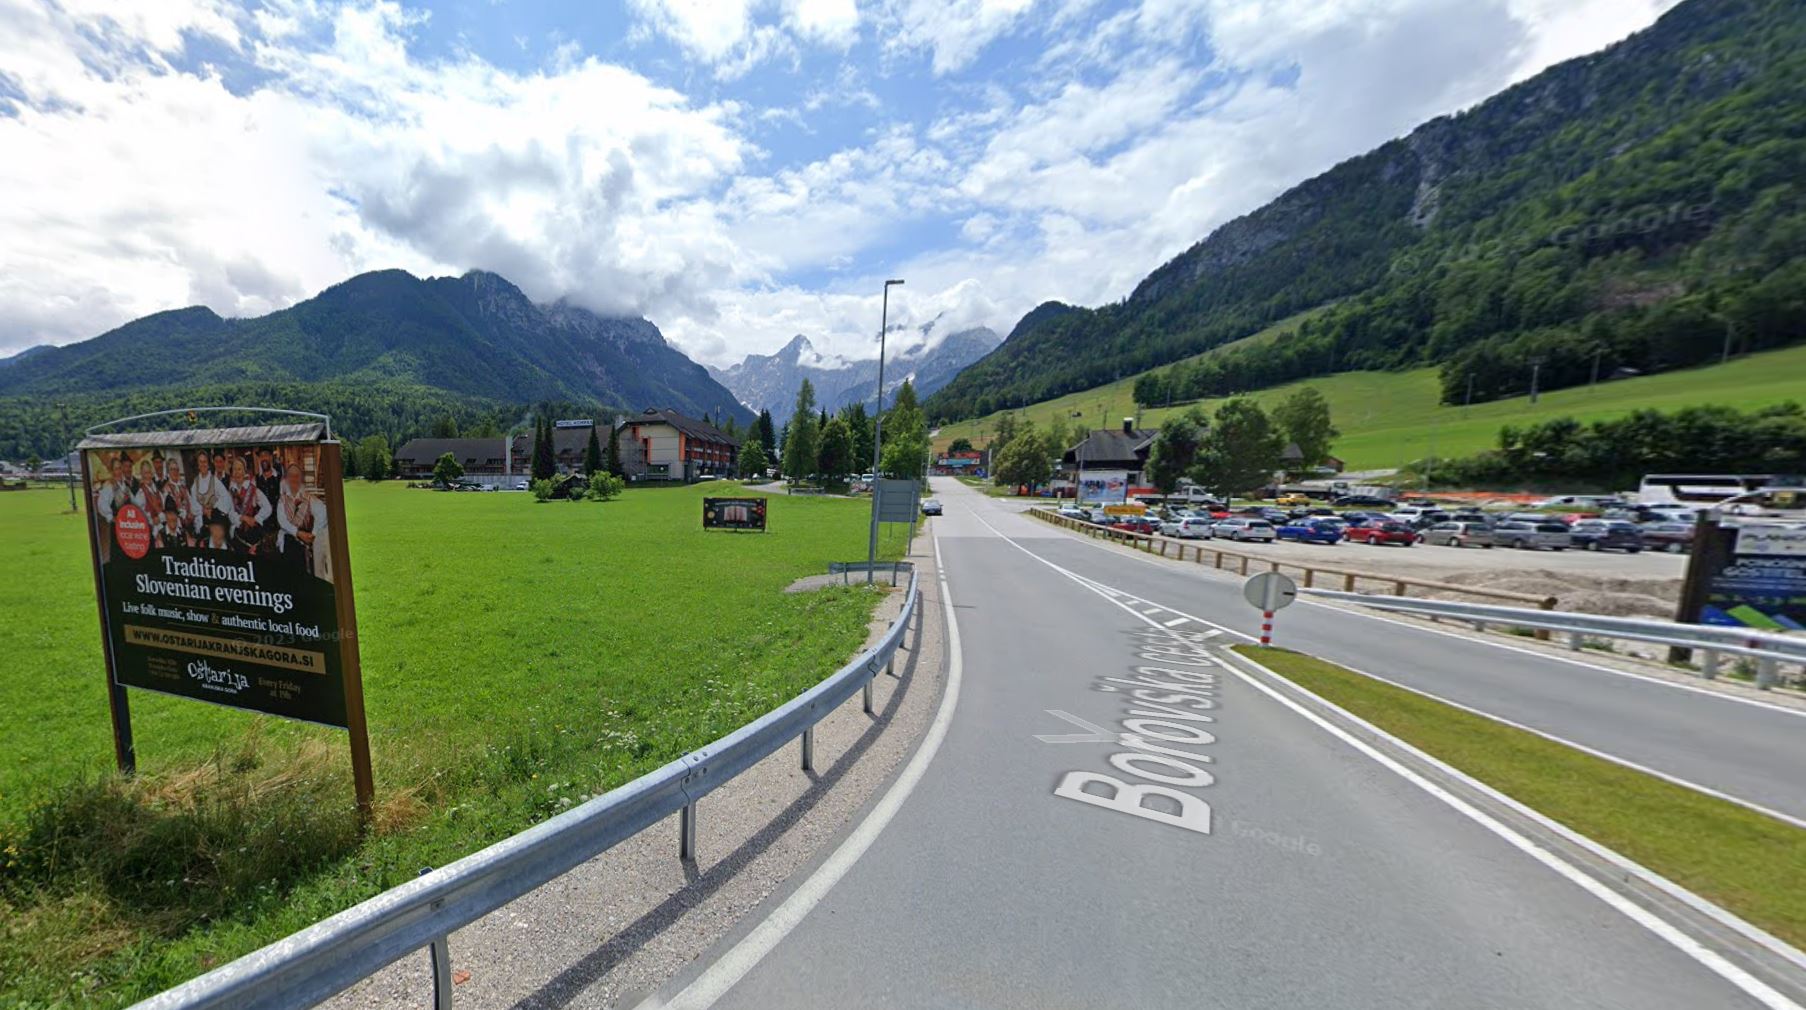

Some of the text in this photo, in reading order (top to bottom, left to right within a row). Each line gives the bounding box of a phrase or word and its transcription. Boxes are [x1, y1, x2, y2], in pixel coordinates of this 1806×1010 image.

[162, 556, 255, 583] Traditional
[136, 574, 294, 613] Slovenian evenings
[122, 601, 140, 614] Live
[141, 603, 157, 616] folk
[158, 607, 185, 622] music,
[186, 609, 209, 623] show
[221, 615, 267, 631] authentic
[269, 620, 294, 635] local
[295, 623, 319, 638] food
[132, 629, 315, 667] WWW.OSTARIJAKRANJSKAGORA.SI
